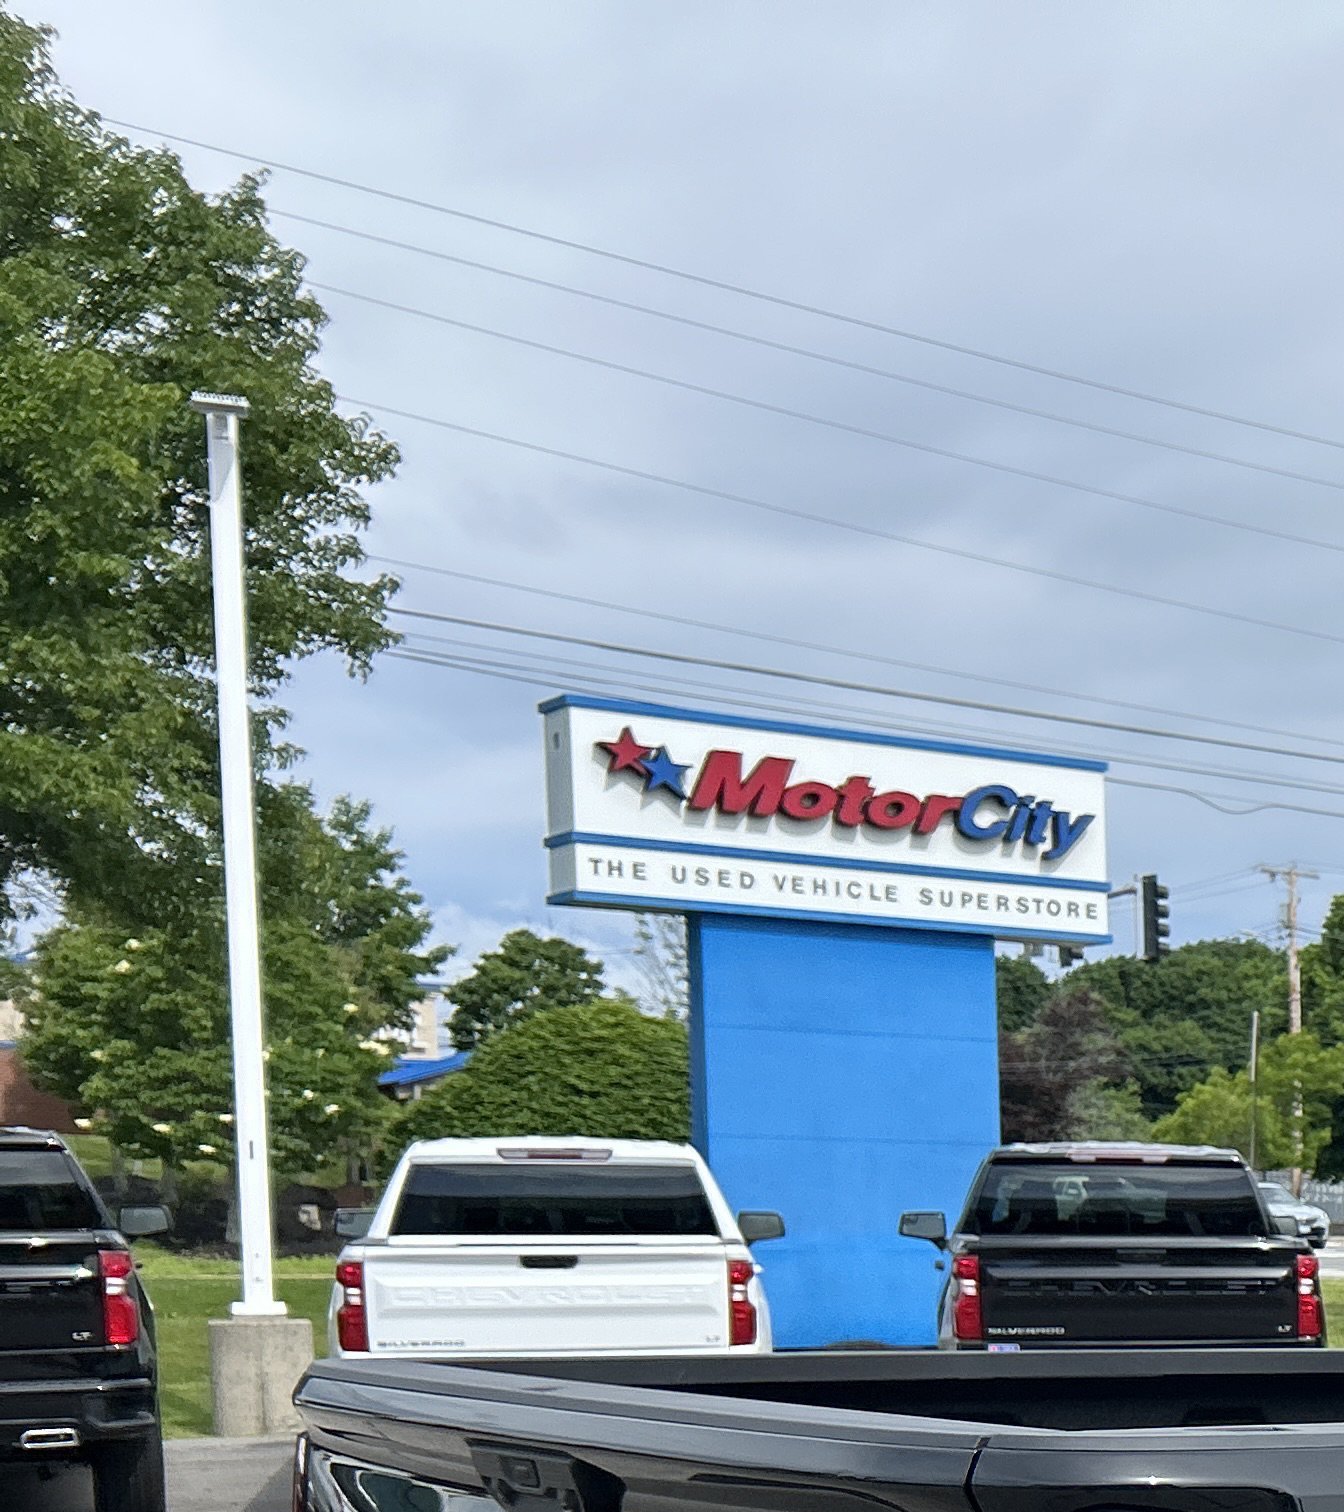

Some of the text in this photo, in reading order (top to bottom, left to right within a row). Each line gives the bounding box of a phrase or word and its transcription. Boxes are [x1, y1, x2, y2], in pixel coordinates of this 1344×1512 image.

[686, 749, 1095, 862] MotorCity
[588, 857, 1098, 920] THE USED VEHICLE SUPERSTORE
